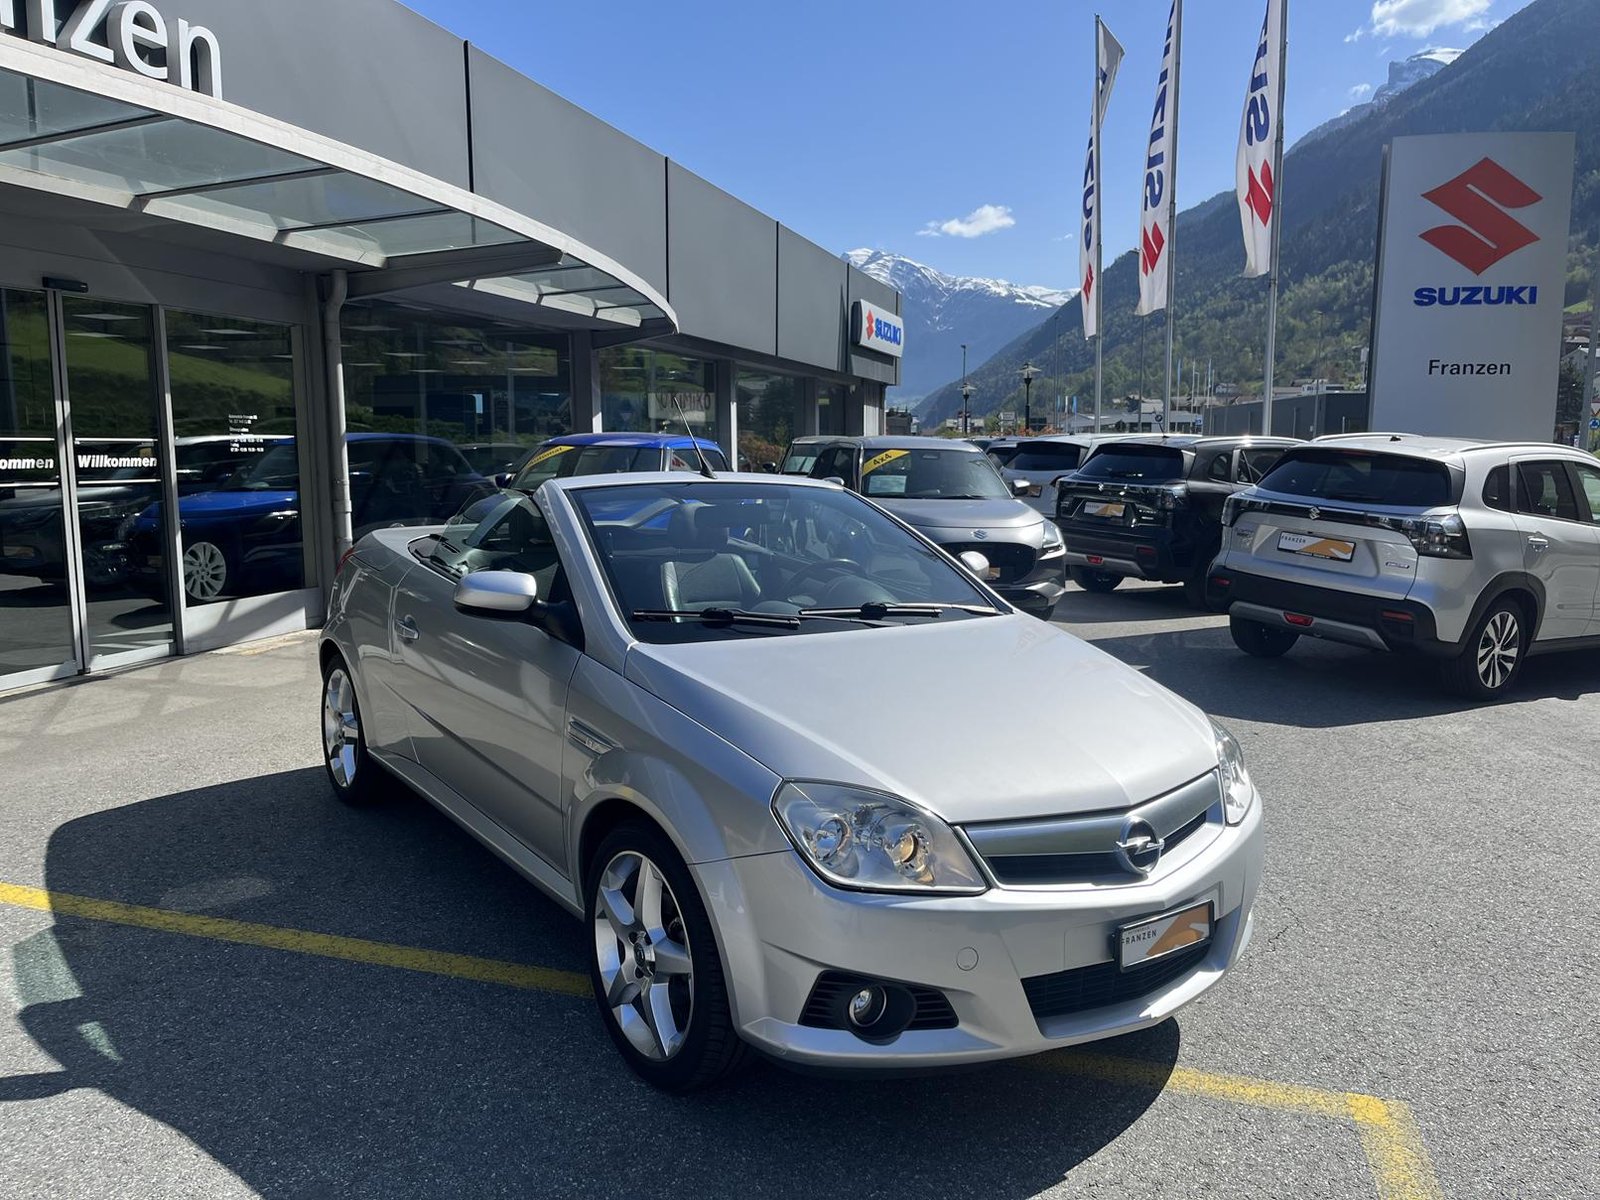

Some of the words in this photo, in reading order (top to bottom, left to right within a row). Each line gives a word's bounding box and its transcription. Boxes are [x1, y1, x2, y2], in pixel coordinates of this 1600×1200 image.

[1413, 285, 1538, 307] SUZUKI
[874, 318, 902, 346] SUZUKI
[1428, 359, 1512, 376] Franzen
[77, 454, 158, 468] Willkommen
[872, 452, 893, 466] 4x4
